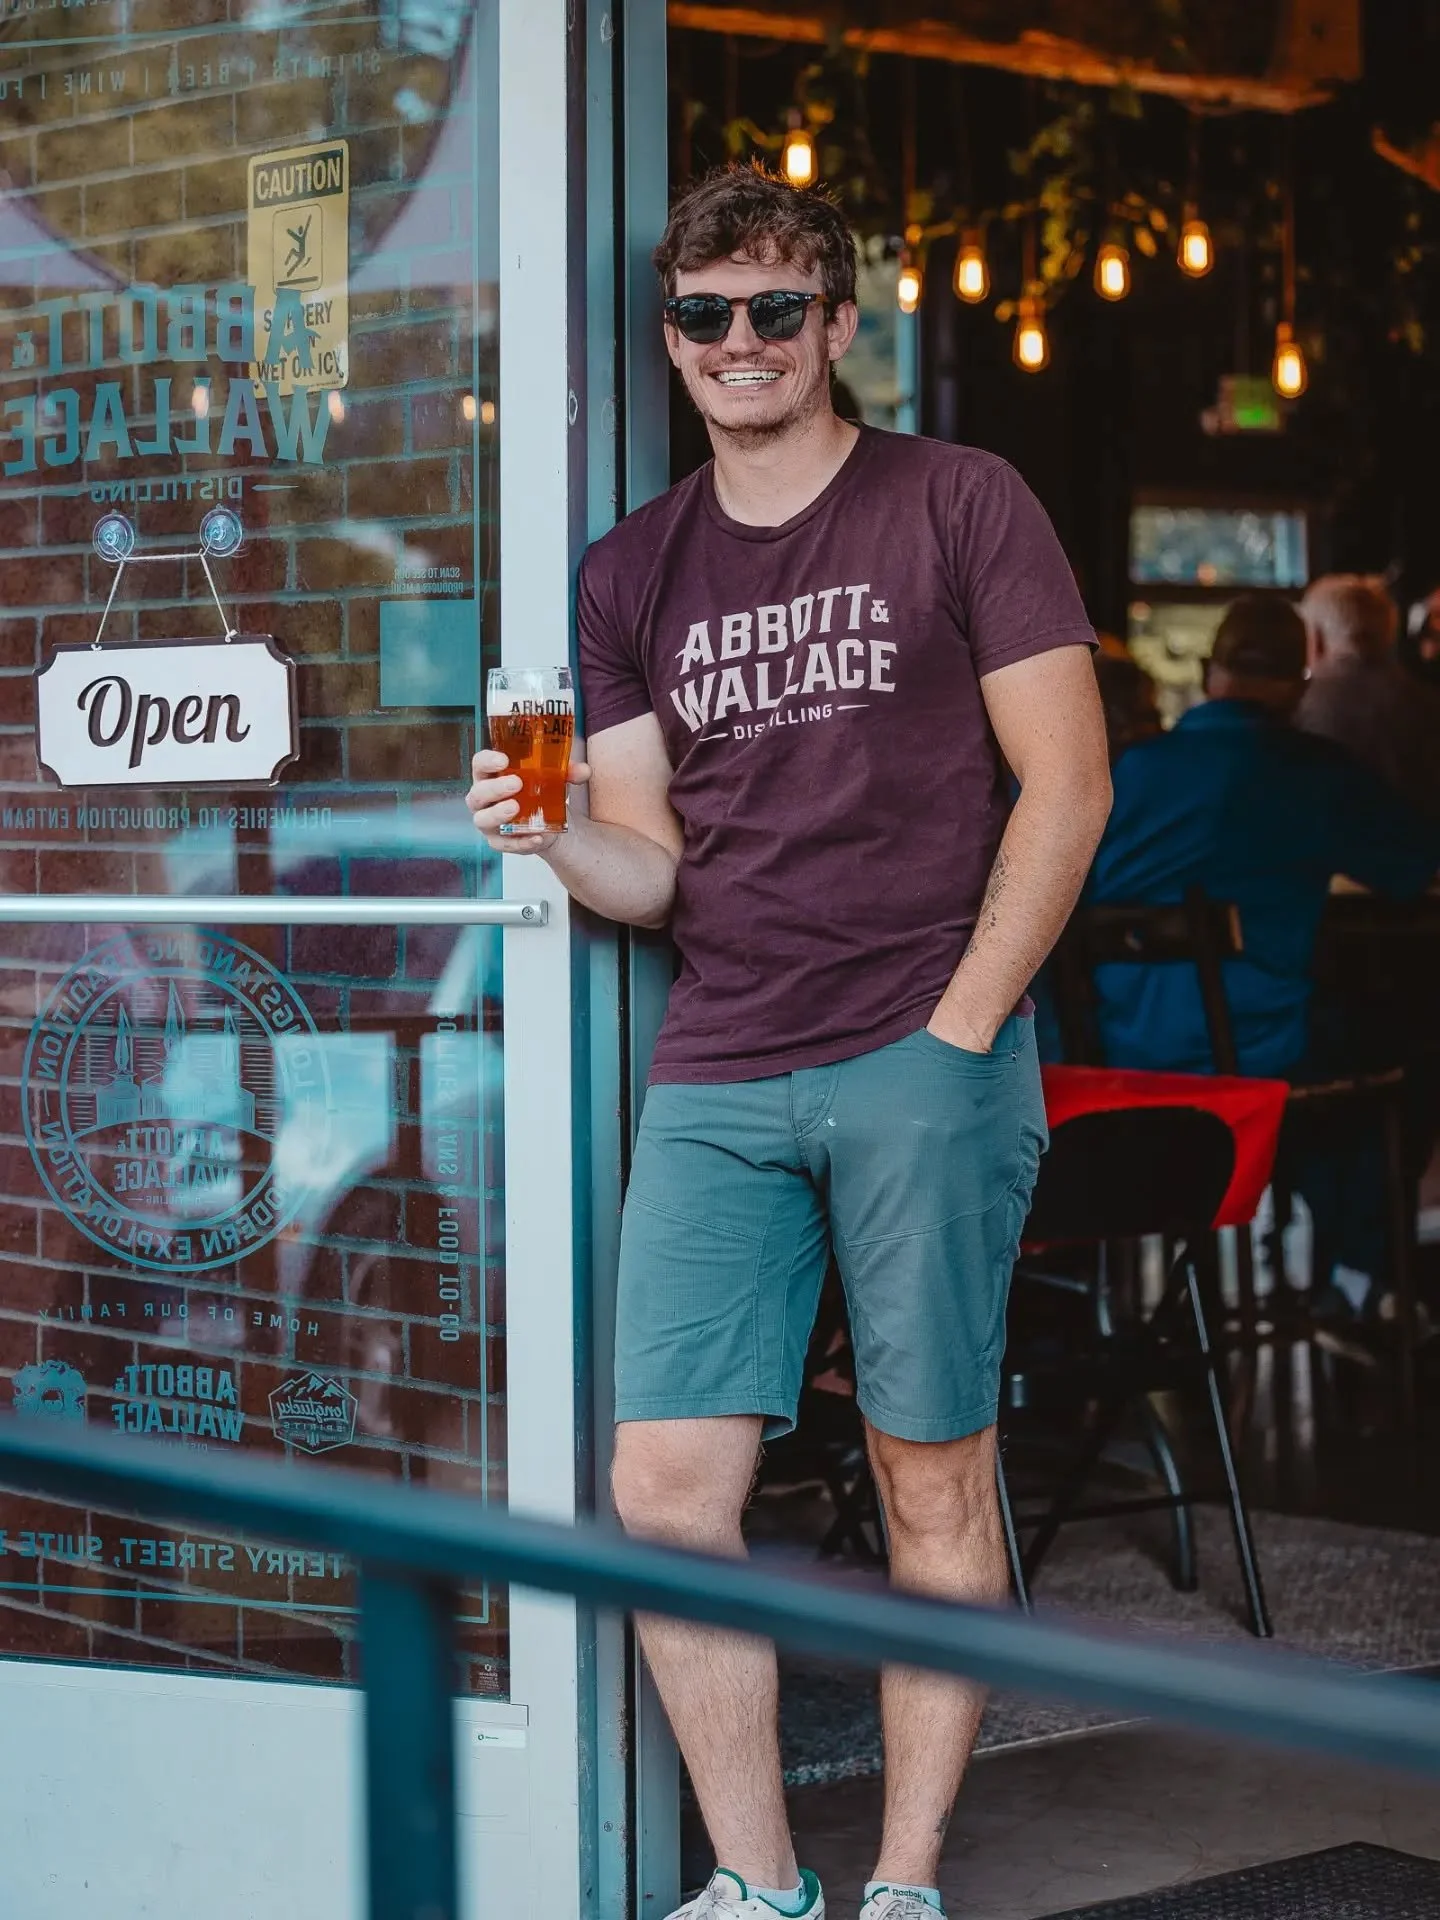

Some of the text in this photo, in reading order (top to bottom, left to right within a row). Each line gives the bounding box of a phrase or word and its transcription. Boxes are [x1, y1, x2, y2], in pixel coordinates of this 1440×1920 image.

[256, 157, 341, 199] CAUTION
[674, 583, 871, 676] ABBOTT
[77, 675, 250, 769] Open
[669, 638, 898, 733] WALLACE
[733, 703, 833, 740] DISILLING
